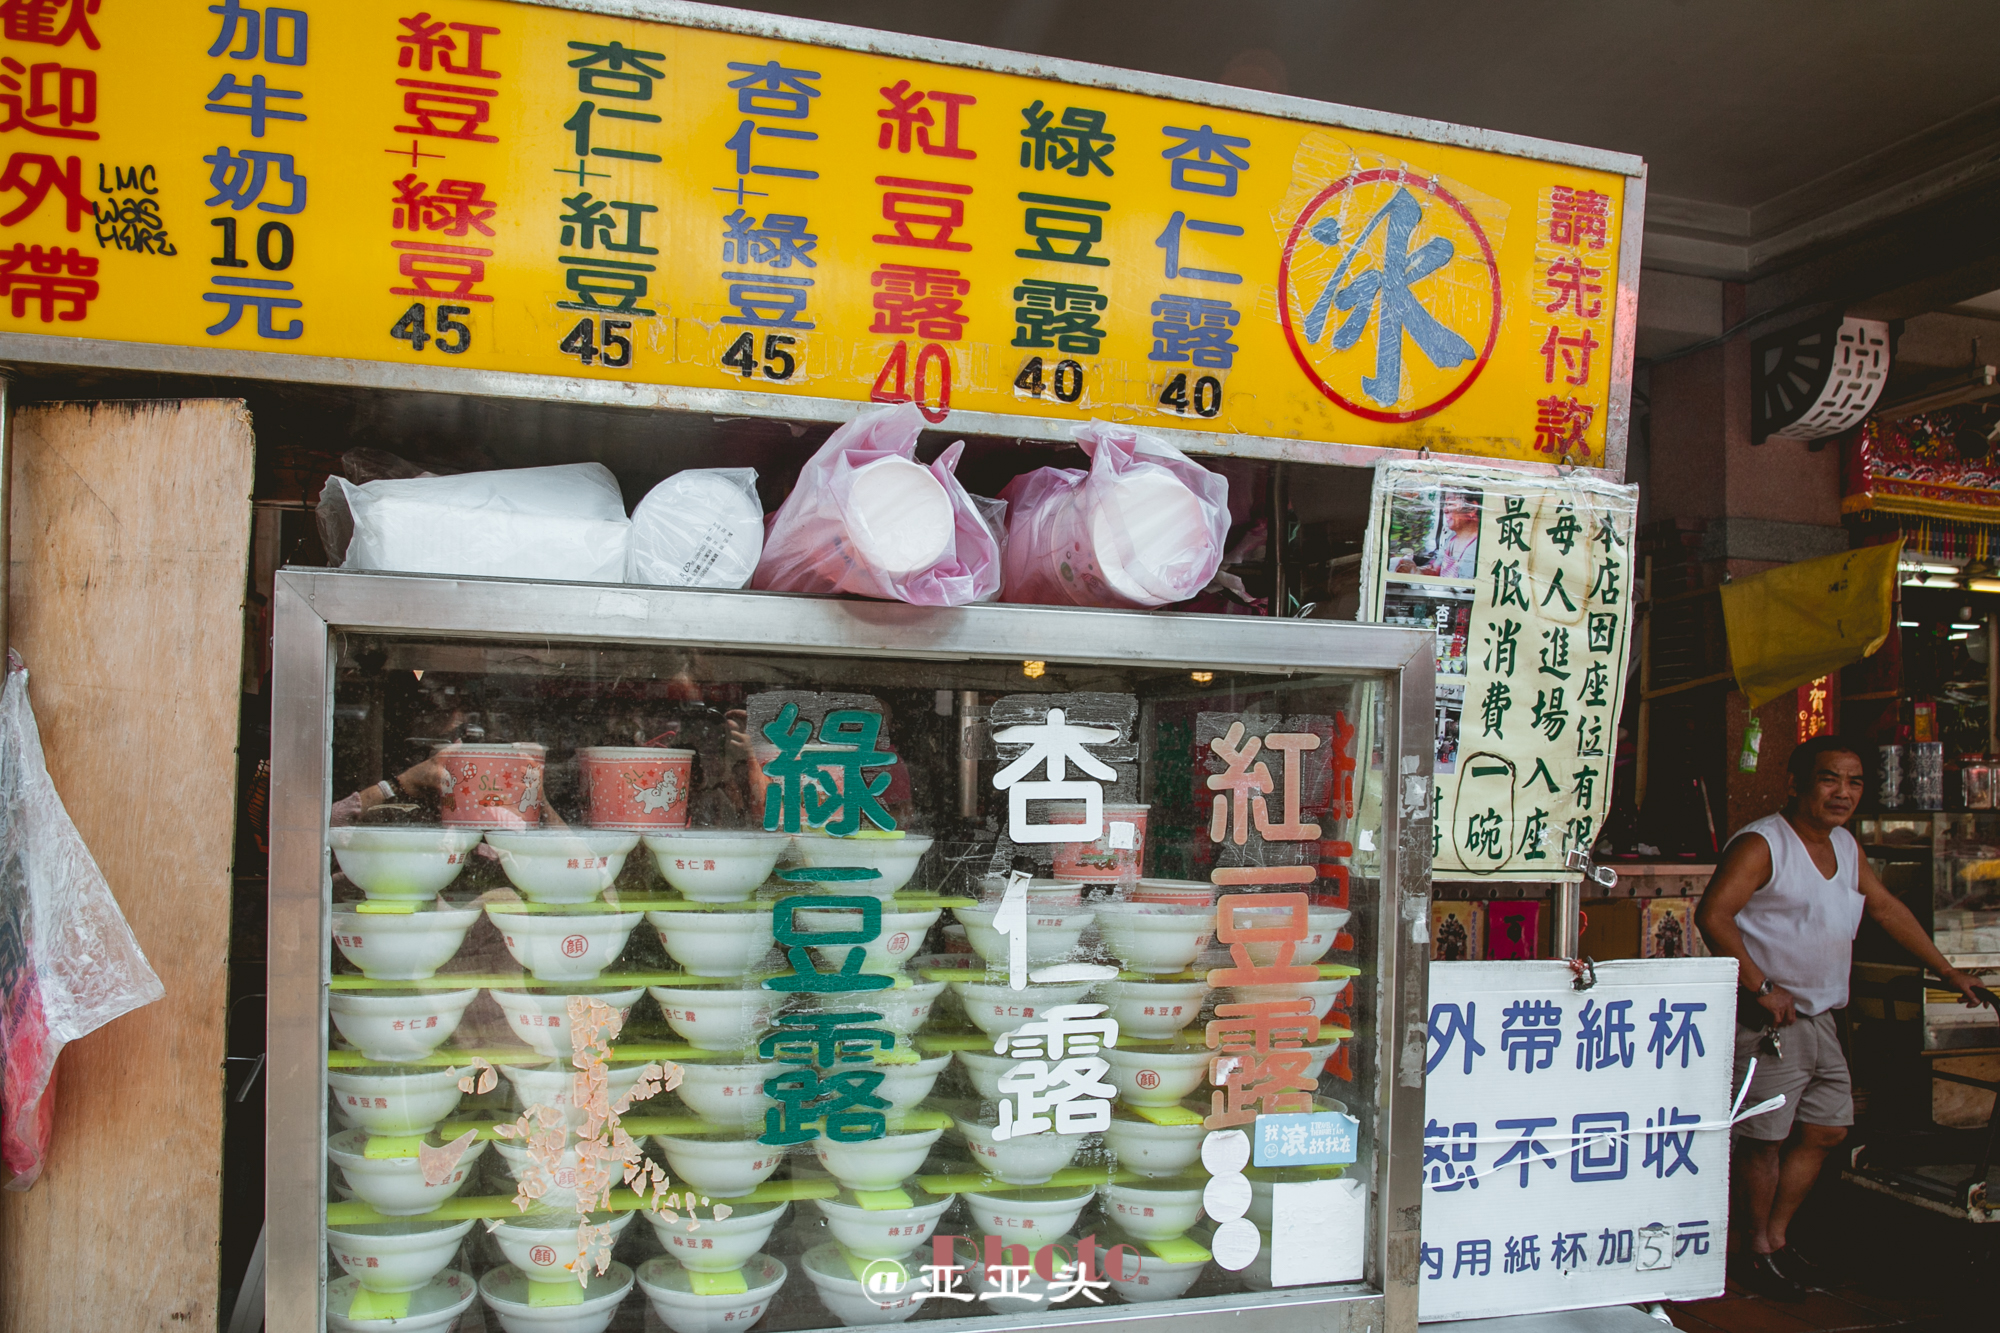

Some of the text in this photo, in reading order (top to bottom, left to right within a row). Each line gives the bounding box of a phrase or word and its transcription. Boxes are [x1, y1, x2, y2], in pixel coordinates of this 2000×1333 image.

[99, 163, 159, 195] LMC
[202, 0, 308, 341] 加牛奶10元
[868, 79, 977, 341] 紅豆露
[1010, 99, 1116, 355] 綠豆露
[95, 223, 178, 256] HERE
[1147, 124, 1251, 370] 杏仁露
[1304, 186, 1477, 408] 冰
[1533, 185, 1610, 457] 請先付款
[390, 302, 472, 355] 45
[559, 318, 633, 368] 45
[721, 331, 796, 381] 45
[870, 340, 952, 424] 40
[1013, 356, 1084, 403] 40
[1159, 373, 1223, 419] 40
[1465, 495, 1532, 861] 最低消費一碗
[1516, 499, 1583, 861] 每人進場入座
[1562, 508, 1625, 857] 本店因座位有限
[675, 859, 716, 871] 杏仁露
[757, 702, 899, 1147] 綠豆露
[991, 708, 1121, 1141] 杏仁露
[1204, 721, 1323, 1131] 紅豆露
[392, 1016, 439, 1031] 杏仁露
[519, 1014, 561, 1028] 綠豆露
[993, 1005, 1035, 1019] 杏仁露
[1143, 1005, 1183, 1017] 綠豆露
[1427, 998, 1708, 1076] 外帶紙杯
[1423, 1106, 1702, 1193] 恕不回收
[888, 1223, 926, 1237] 綠豆露
[993, 1215, 1034, 1229] 杏仁露
[1116, 1203, 1155, 1218] 杏仁露
[673, 1235, 714, 1250] 綠豆露
